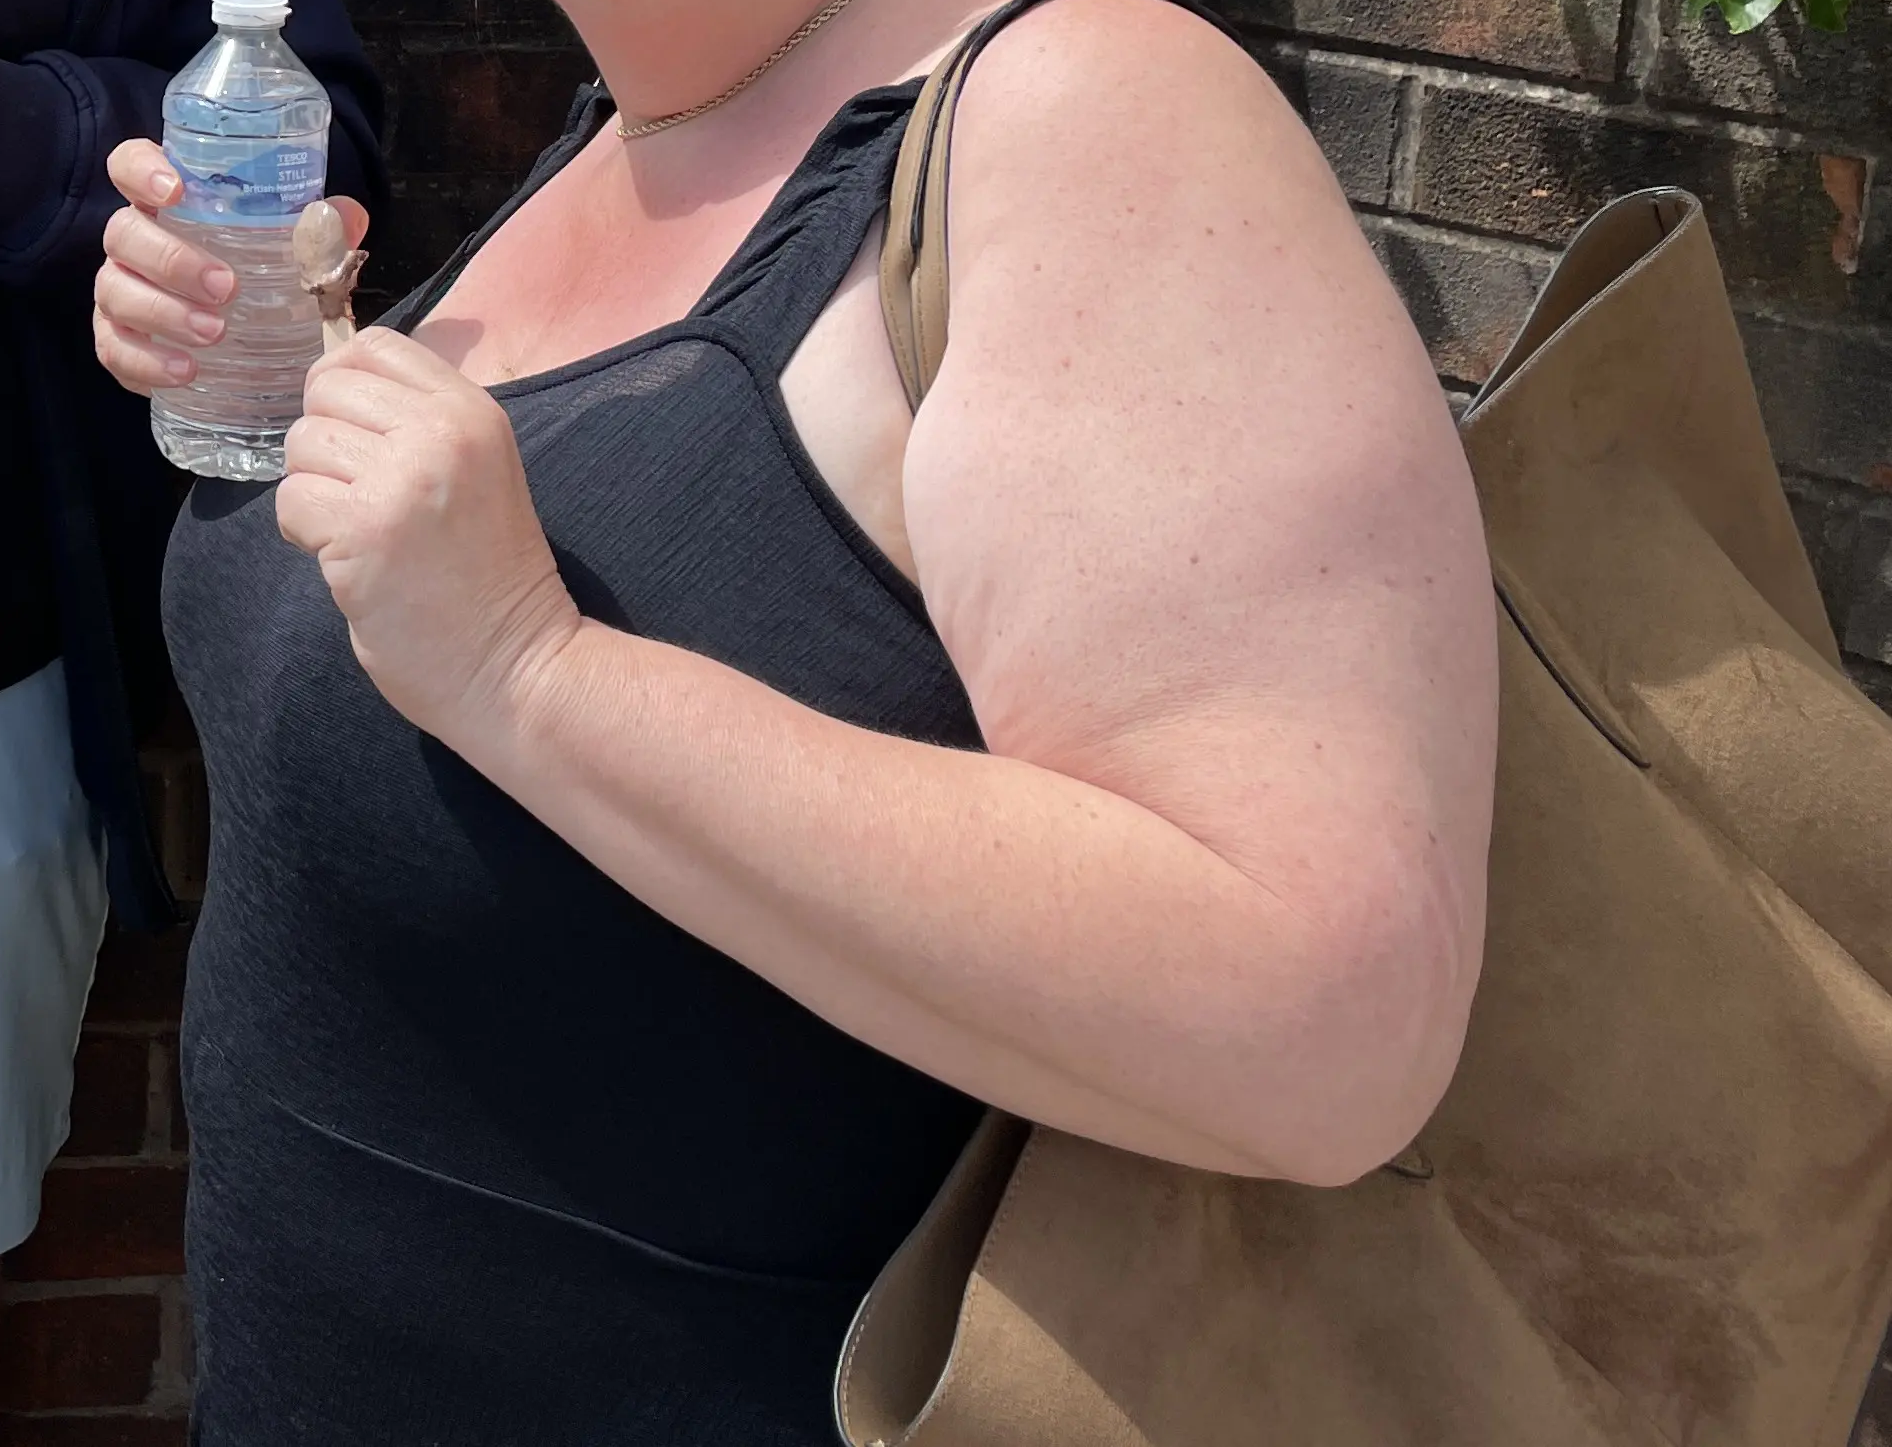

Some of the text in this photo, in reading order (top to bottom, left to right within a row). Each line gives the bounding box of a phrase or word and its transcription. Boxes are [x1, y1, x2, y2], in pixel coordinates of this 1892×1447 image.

[276, 152, 307, 164] TESCO
[278, 169, 307, 182] STILL
[243, 183, 275, 194] British
[279, 192, 305, 203] Water
